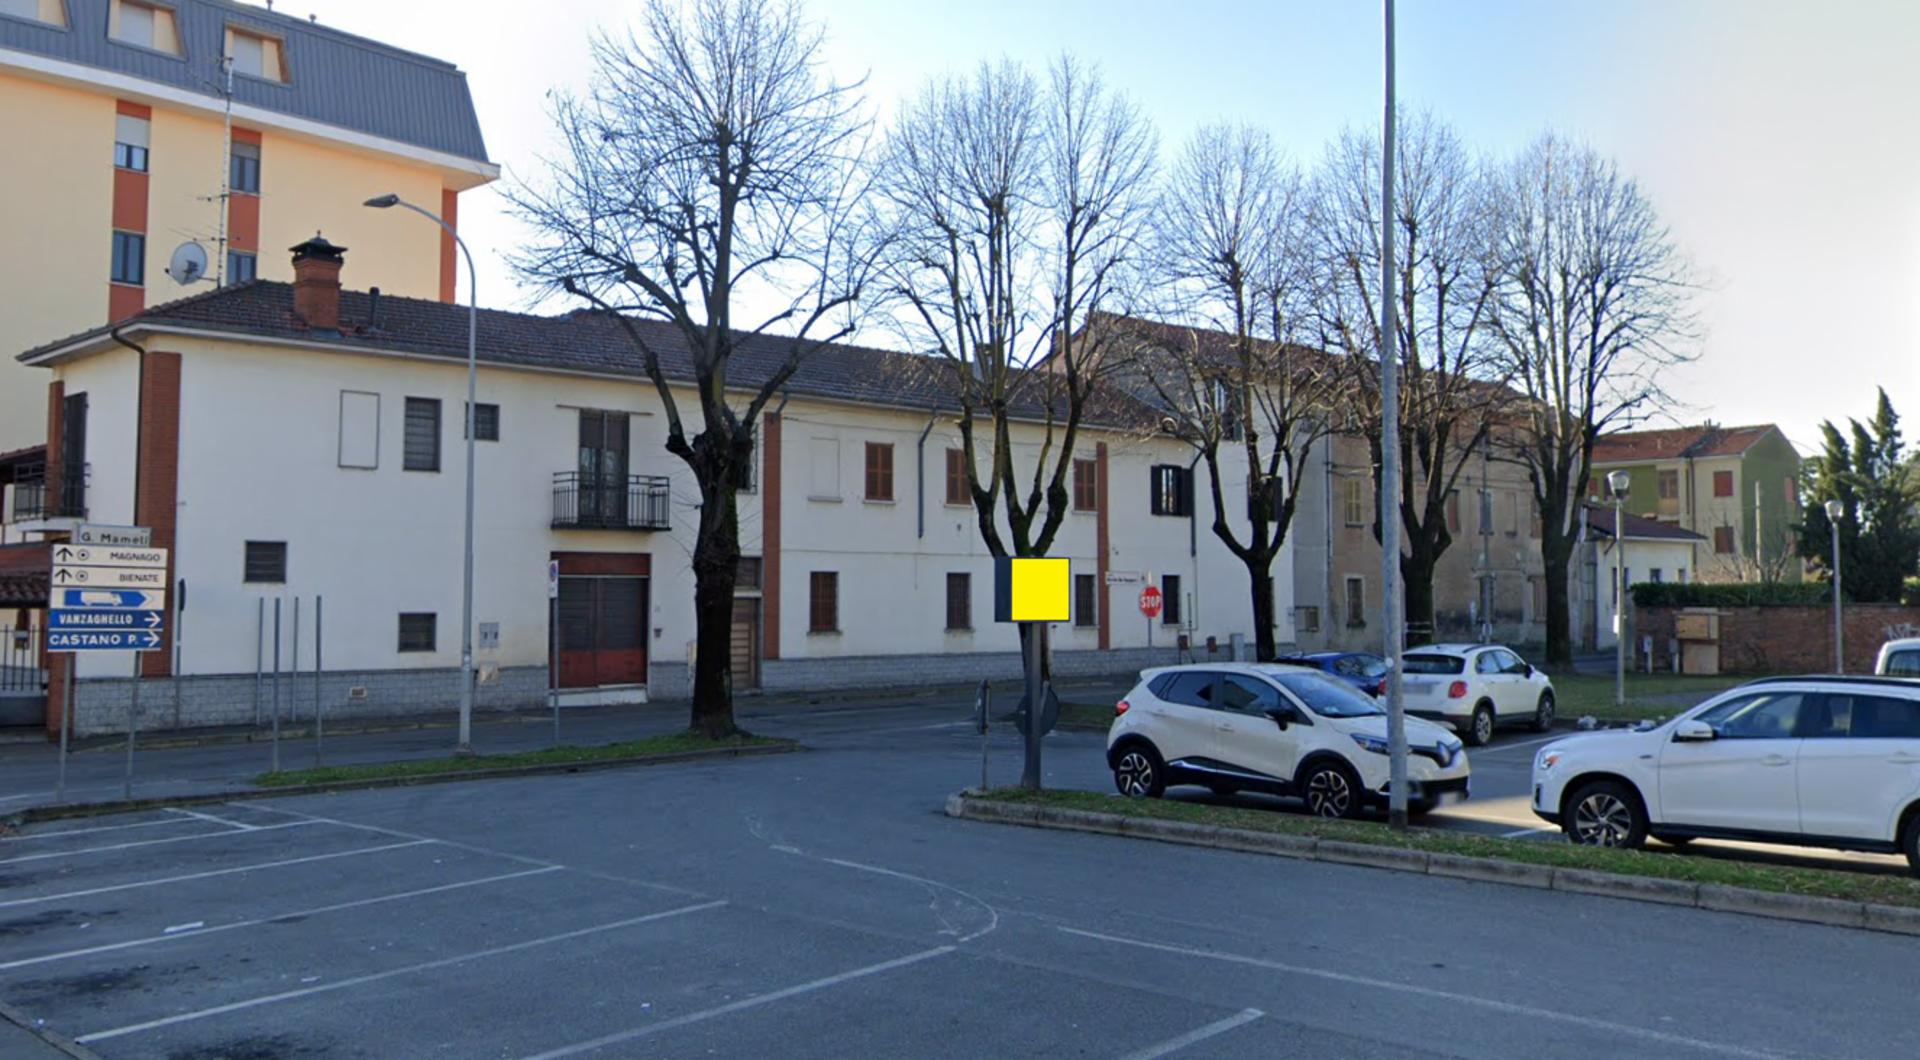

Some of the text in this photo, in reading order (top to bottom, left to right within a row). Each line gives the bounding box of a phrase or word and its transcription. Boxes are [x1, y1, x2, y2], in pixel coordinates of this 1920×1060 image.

[101, 534, 148, 545] Mameli
[110, 552, 161, 562] MAGNAGO
[119, 574, 159, 583] BIENATE
[1140, 596, 1161, 608] STOP
[59, 614, 133, 625] VANZAGHELLO
[50, 635, 138, 645] CASTANO P.
